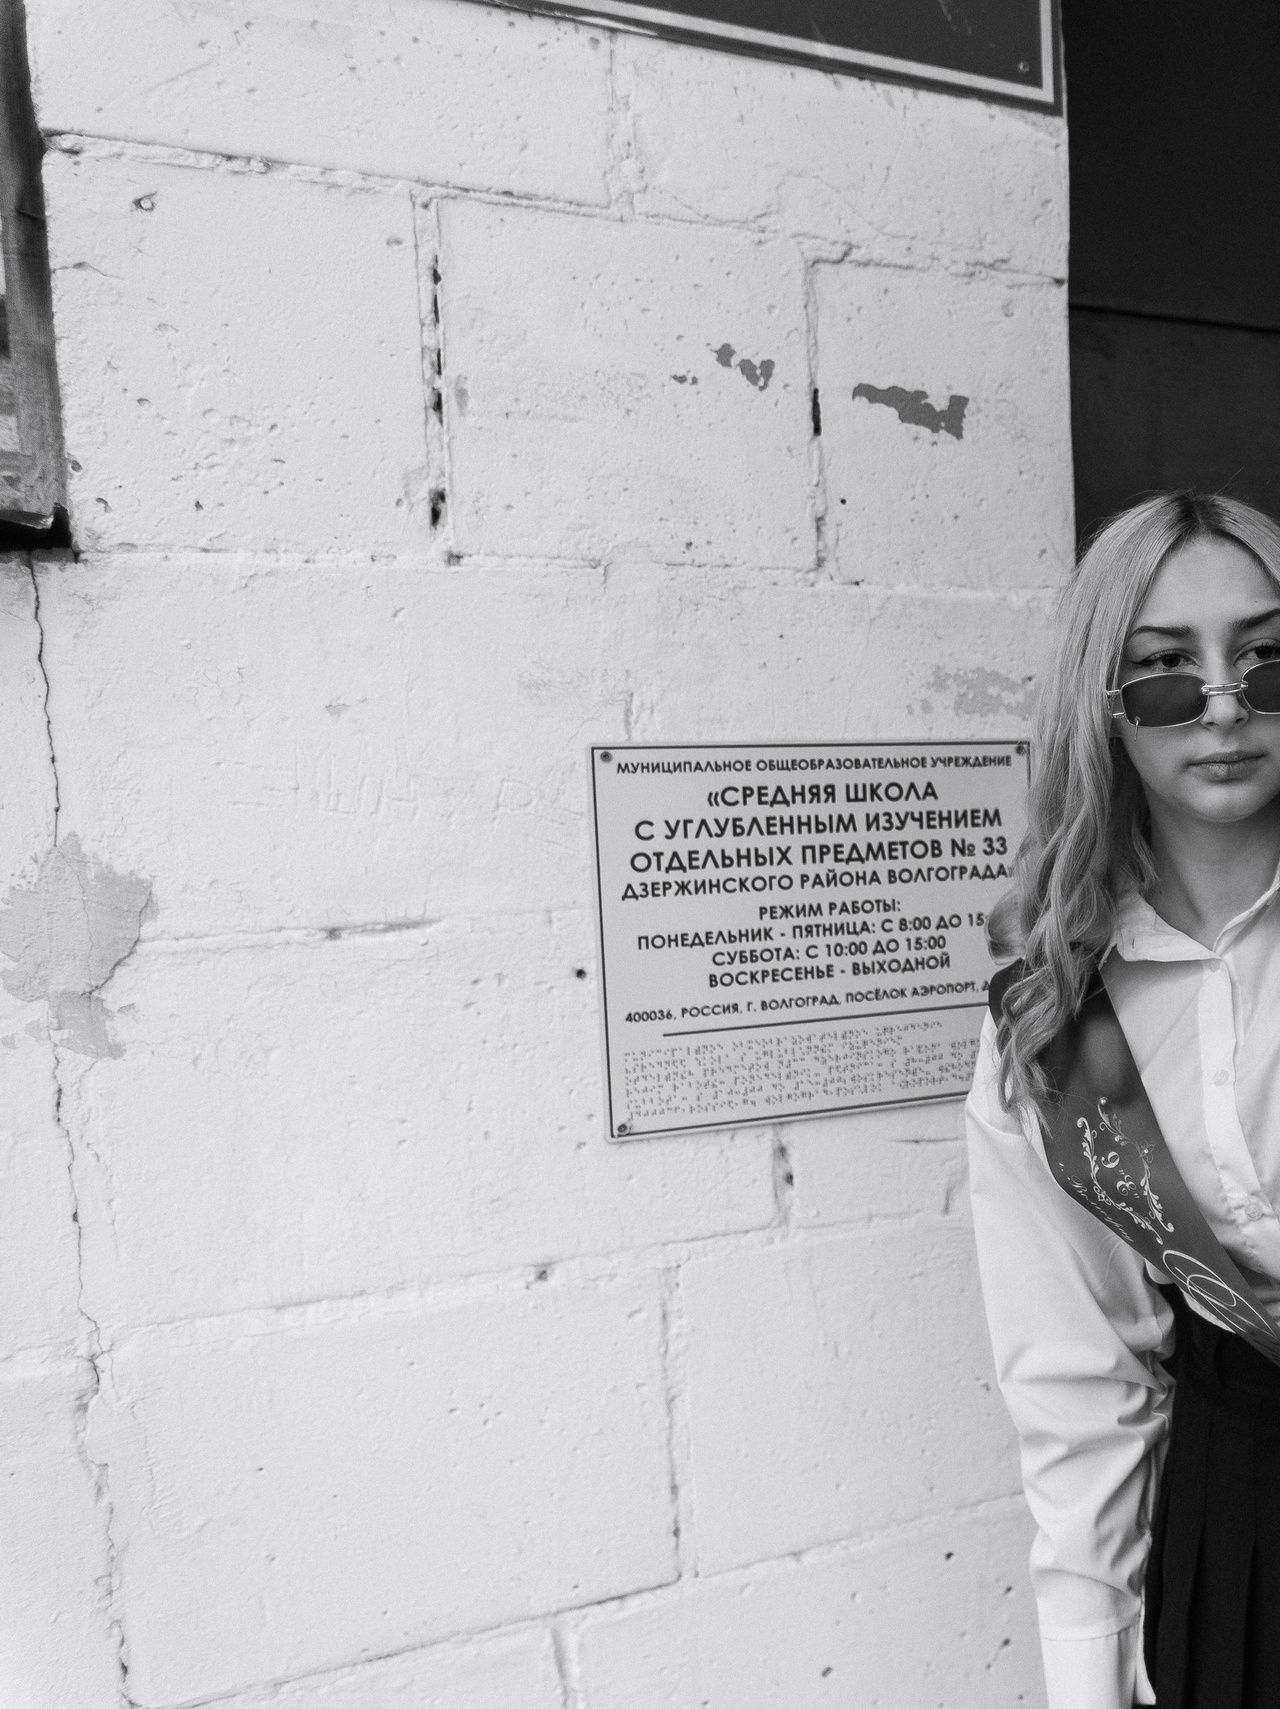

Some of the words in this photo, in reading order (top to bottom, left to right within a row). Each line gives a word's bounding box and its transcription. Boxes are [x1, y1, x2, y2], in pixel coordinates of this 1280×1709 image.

[617, 760, 752, 774] МУНИЦИПАЛЬНОЕ
[756, 756, 928, 773] ОБЩЕОБРАЗОВАТЕЛЬНОЕ
[930, 755, 1012, 769] УЧРЕЖДЕНИЕ
[707, 784, 836, 808] «СРЕДНЯЯ
[845, 781, 939, 803] ШКОЛА
[635, 820, 655, 841] С
[664, 812, 857, 840] УГЛУБЛЕННЫМ
[865, 807, 1002, 832] ИЗУЧЕНИЕМ
[630, 845, 793, 874] ОТДЕЛЬНЫХ
[801, 839, 943, 865] ПРЕДМЕТОВ
[951, 838, 976, 858] №
[982, 836, 1008, 856] 33
[621, 874, 794, 901] ДЗЕРЖИНСКОГО
[800, 868, 882, 889] РАЙОНА
[759, 902, 823, 920] РЕЖИМ
[829, 898, 901, 916] РАБОТЫ:
[637, 927, 774, 950] ПОНЕДЕЛЬНИК
[792, 920, 876, 940] ПЯТНИЦА:
[881, 918, 894, 933] С
[899, 916, 932, 932] 8:00
[935, 913, 962, 931] ДО
[712, 947, 800, 966] СУББОТА:
[805, 944, 819, 959] С
[825, 941, 868, 958] 10:00
[872, 938, 900, 956] ДО
[905, 935, 947, 951] 15:00
[709, 964, 834, 988] ВОСКРЕСЕНЬЕ
[852, 952, 951, 976] ВЫХОДНОЙ
[625, 1009, 677, 1023] 400036,
[681, 1003, 743, 1018] РОССИЯ,
[746, 1002, 757, 1013] Г.
[761, 994, 842, 1011] ВОЛГОГРАД,
[845, 986, 907, 1004] ПОСЁЛОК
[911, 981, 979, 998] АЭРОПОРТ,
[1101, 1151, 1120, 1169] 9
